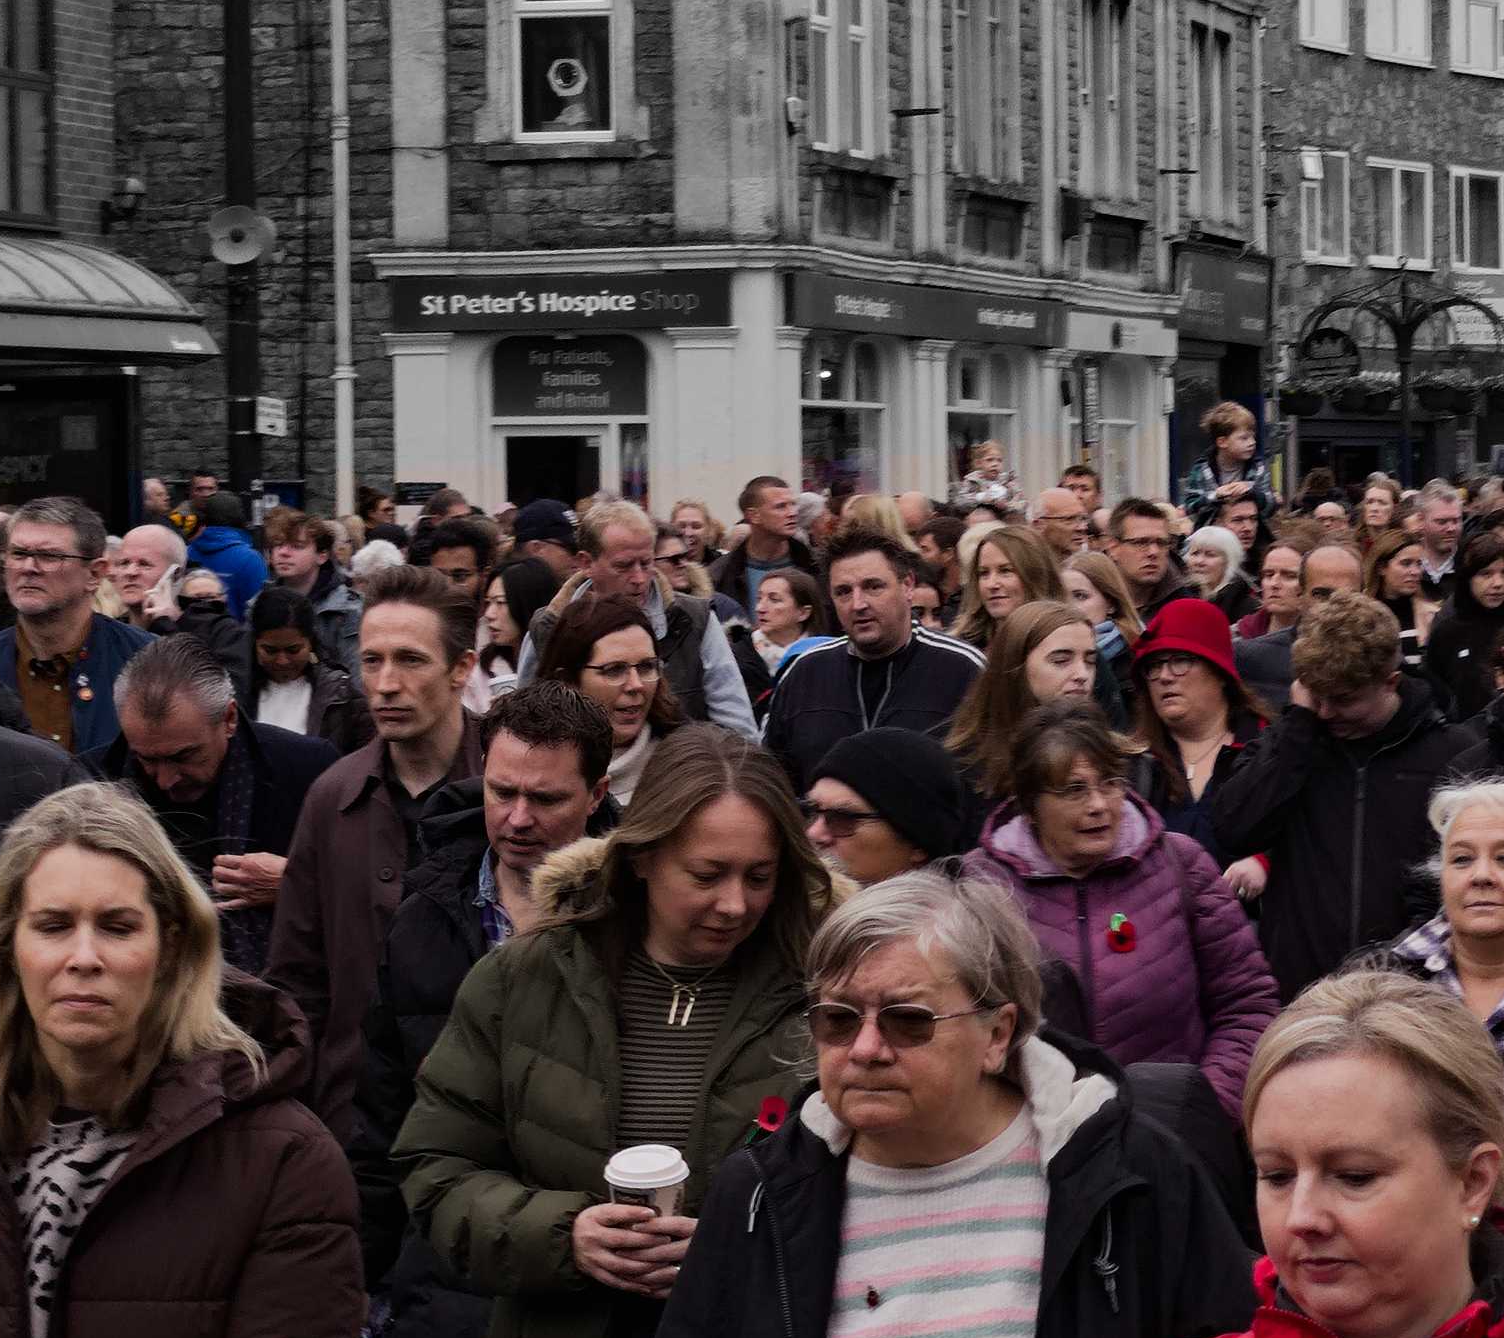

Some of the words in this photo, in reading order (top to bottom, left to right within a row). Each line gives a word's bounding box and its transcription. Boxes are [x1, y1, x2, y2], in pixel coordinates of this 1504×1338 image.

[420, 293, 447, 315] St
[449, 290, 536, 315] Peter's
[538, 289, 637, 316] Hospice
[639, 288, 701, 315] Shop
[541, 370, 601, 387] Families
[535, 392, 563, 409] and
[564, 390, 610, 409] Bristol
